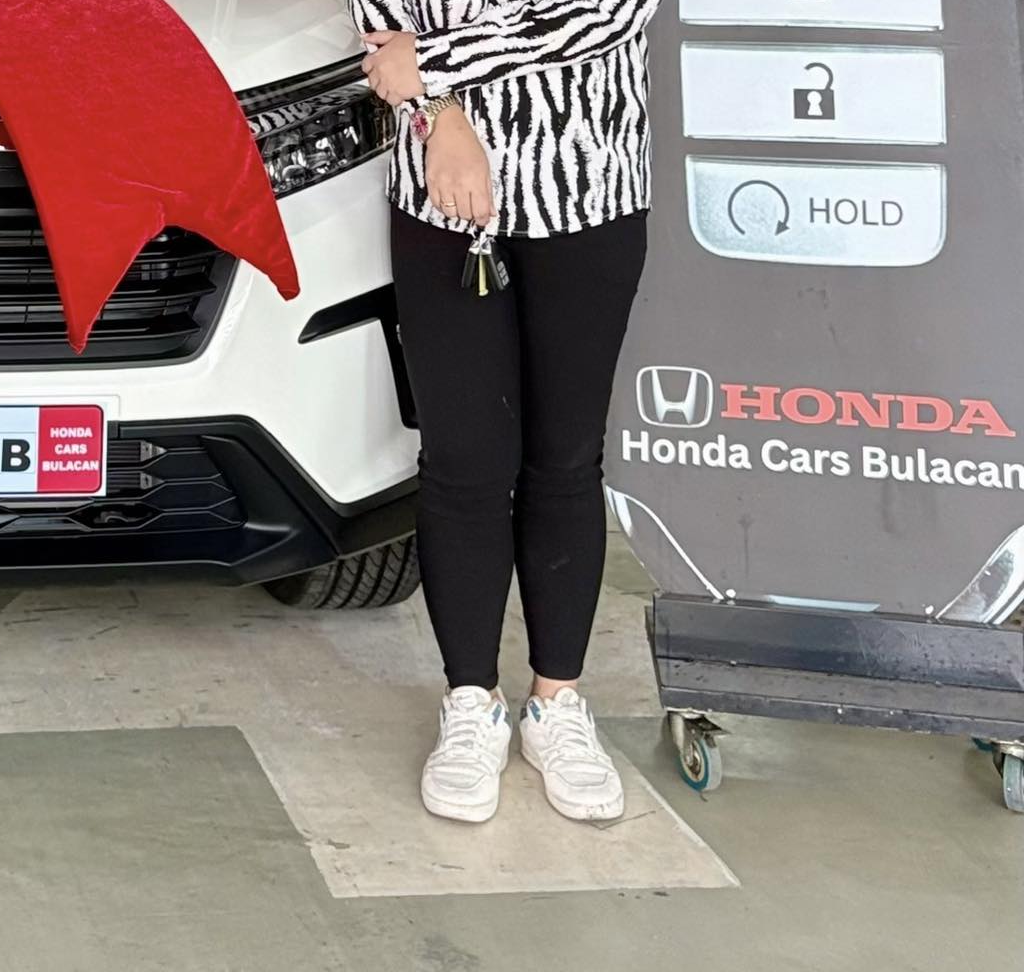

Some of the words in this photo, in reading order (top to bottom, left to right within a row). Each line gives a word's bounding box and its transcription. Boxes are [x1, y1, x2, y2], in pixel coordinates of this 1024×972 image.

[809, 197, 903, 226] HOLD
[720, 383, 1017, 438] HONDA
[49, 427, 93, 439] HONDA
[54, 444, 88, 455] CARS
[622, 429, 752, 469] Honda
[761, 439, 850, 476] Cars
[862, 446, 1024, 490] Bulacan
[42, 460, 100, 472] BULACAN
